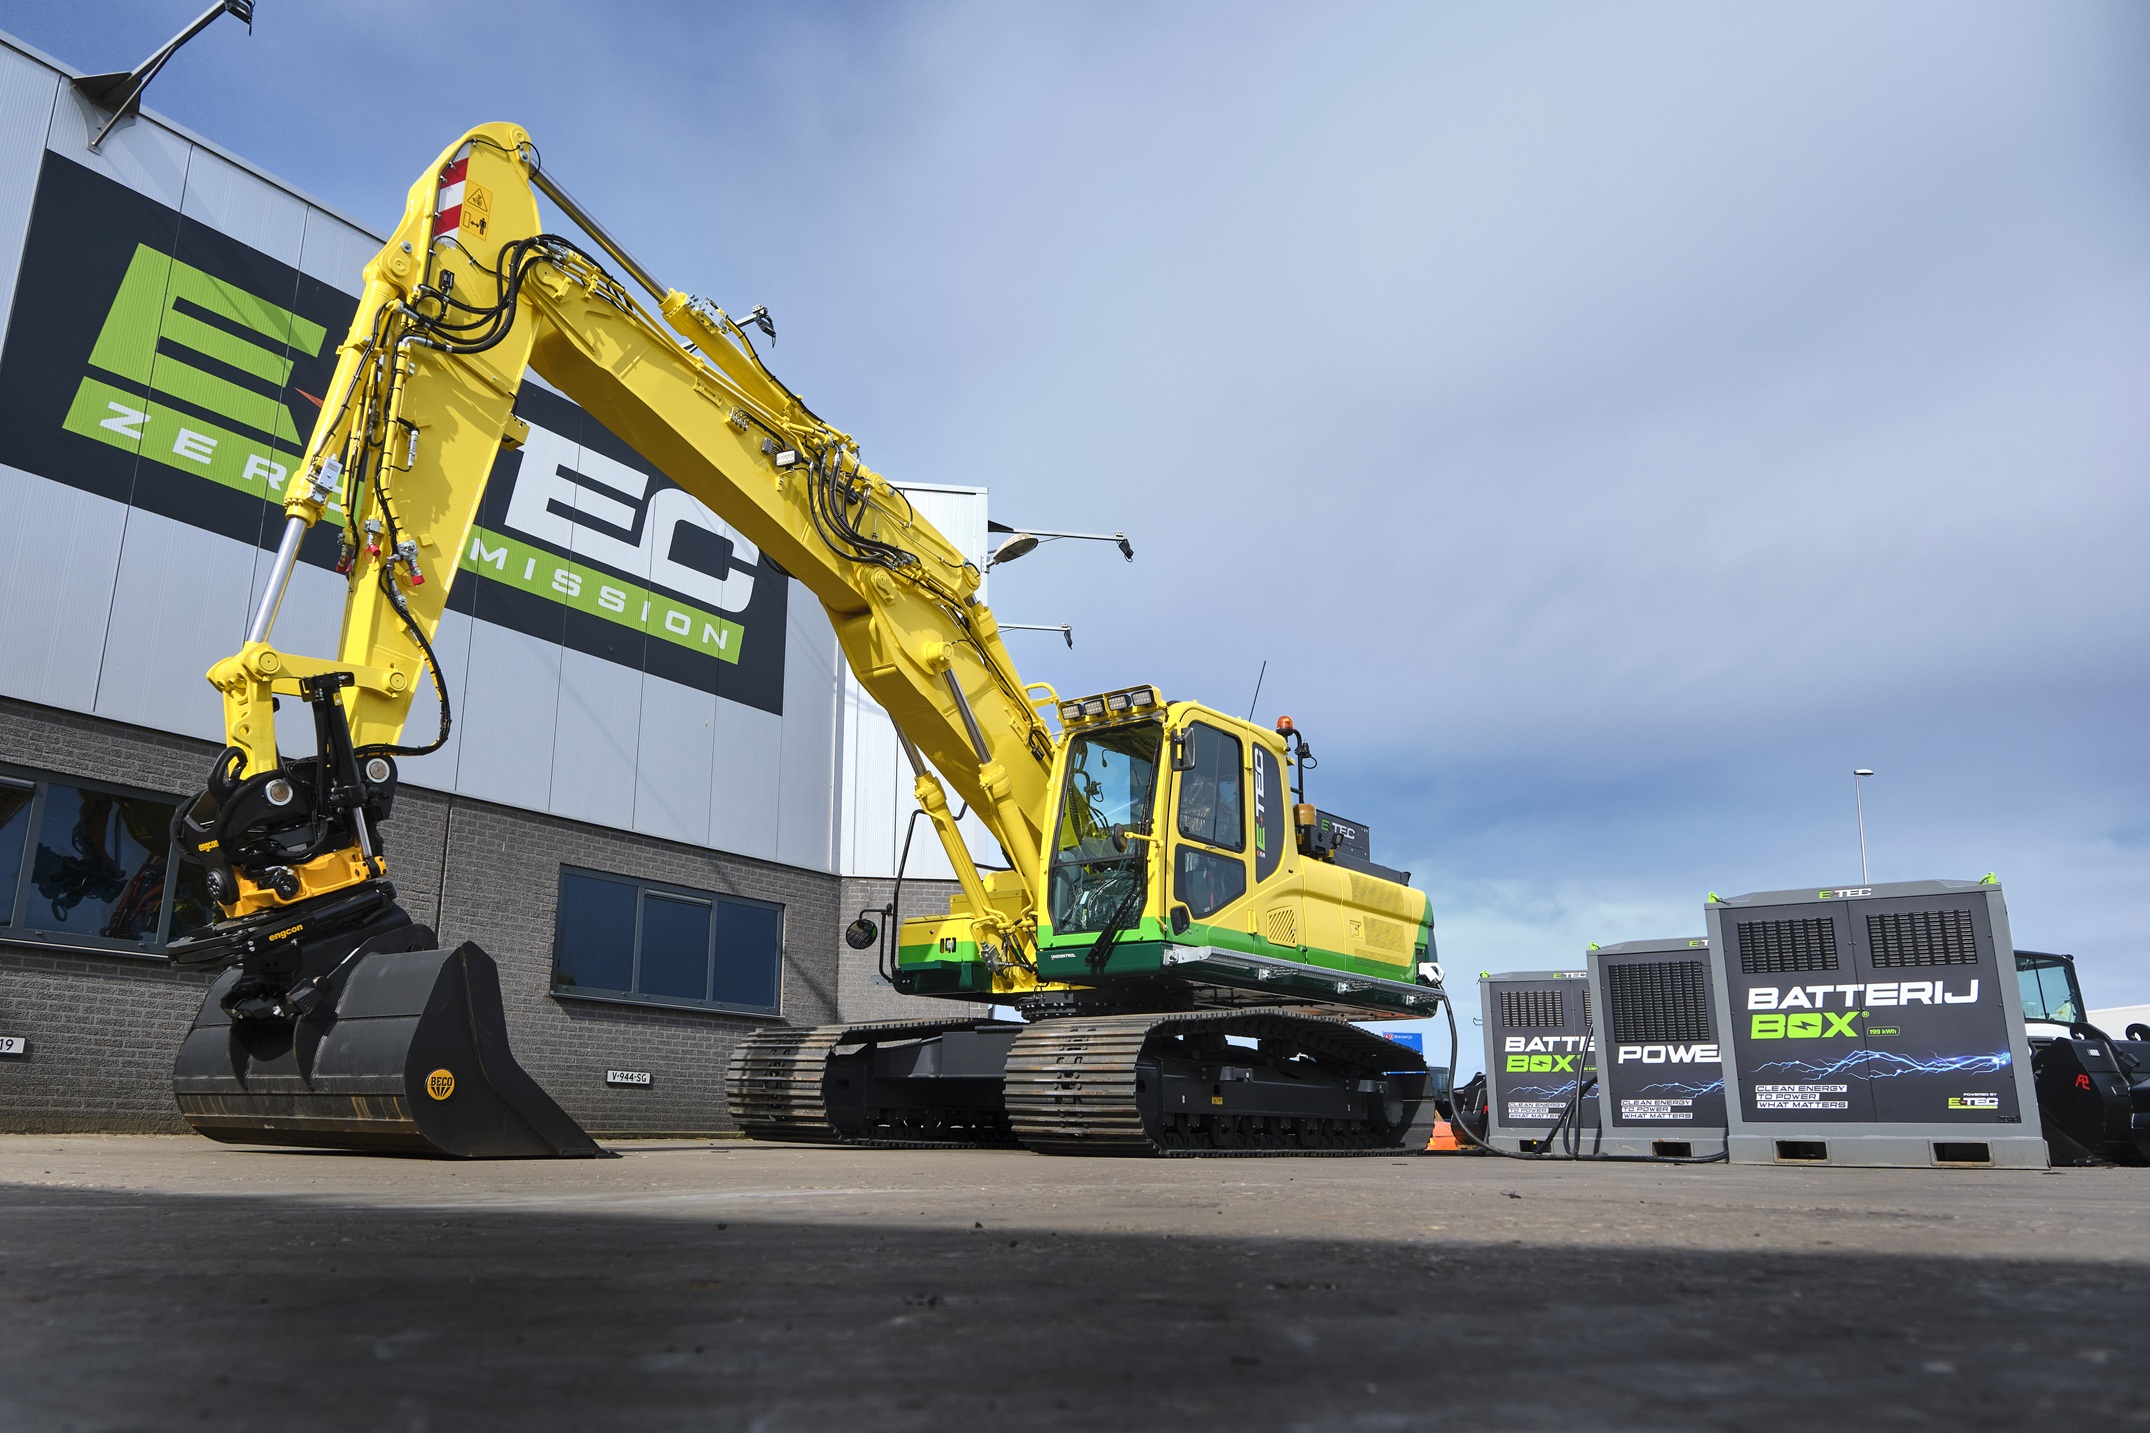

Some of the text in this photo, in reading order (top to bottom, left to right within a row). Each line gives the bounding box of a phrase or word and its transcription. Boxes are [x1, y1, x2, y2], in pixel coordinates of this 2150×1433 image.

[99, 401, 728, 650] ZER MISSION
[268, 924, 303, 942] engcon
[1747, 979, 1979, 1010] BATTERIJ
[1617, 1044, 1722, 1064] POWE
[430, 1076, 453, 1088] BECO
[611, 1071, 648, 1083] V-944-SG
